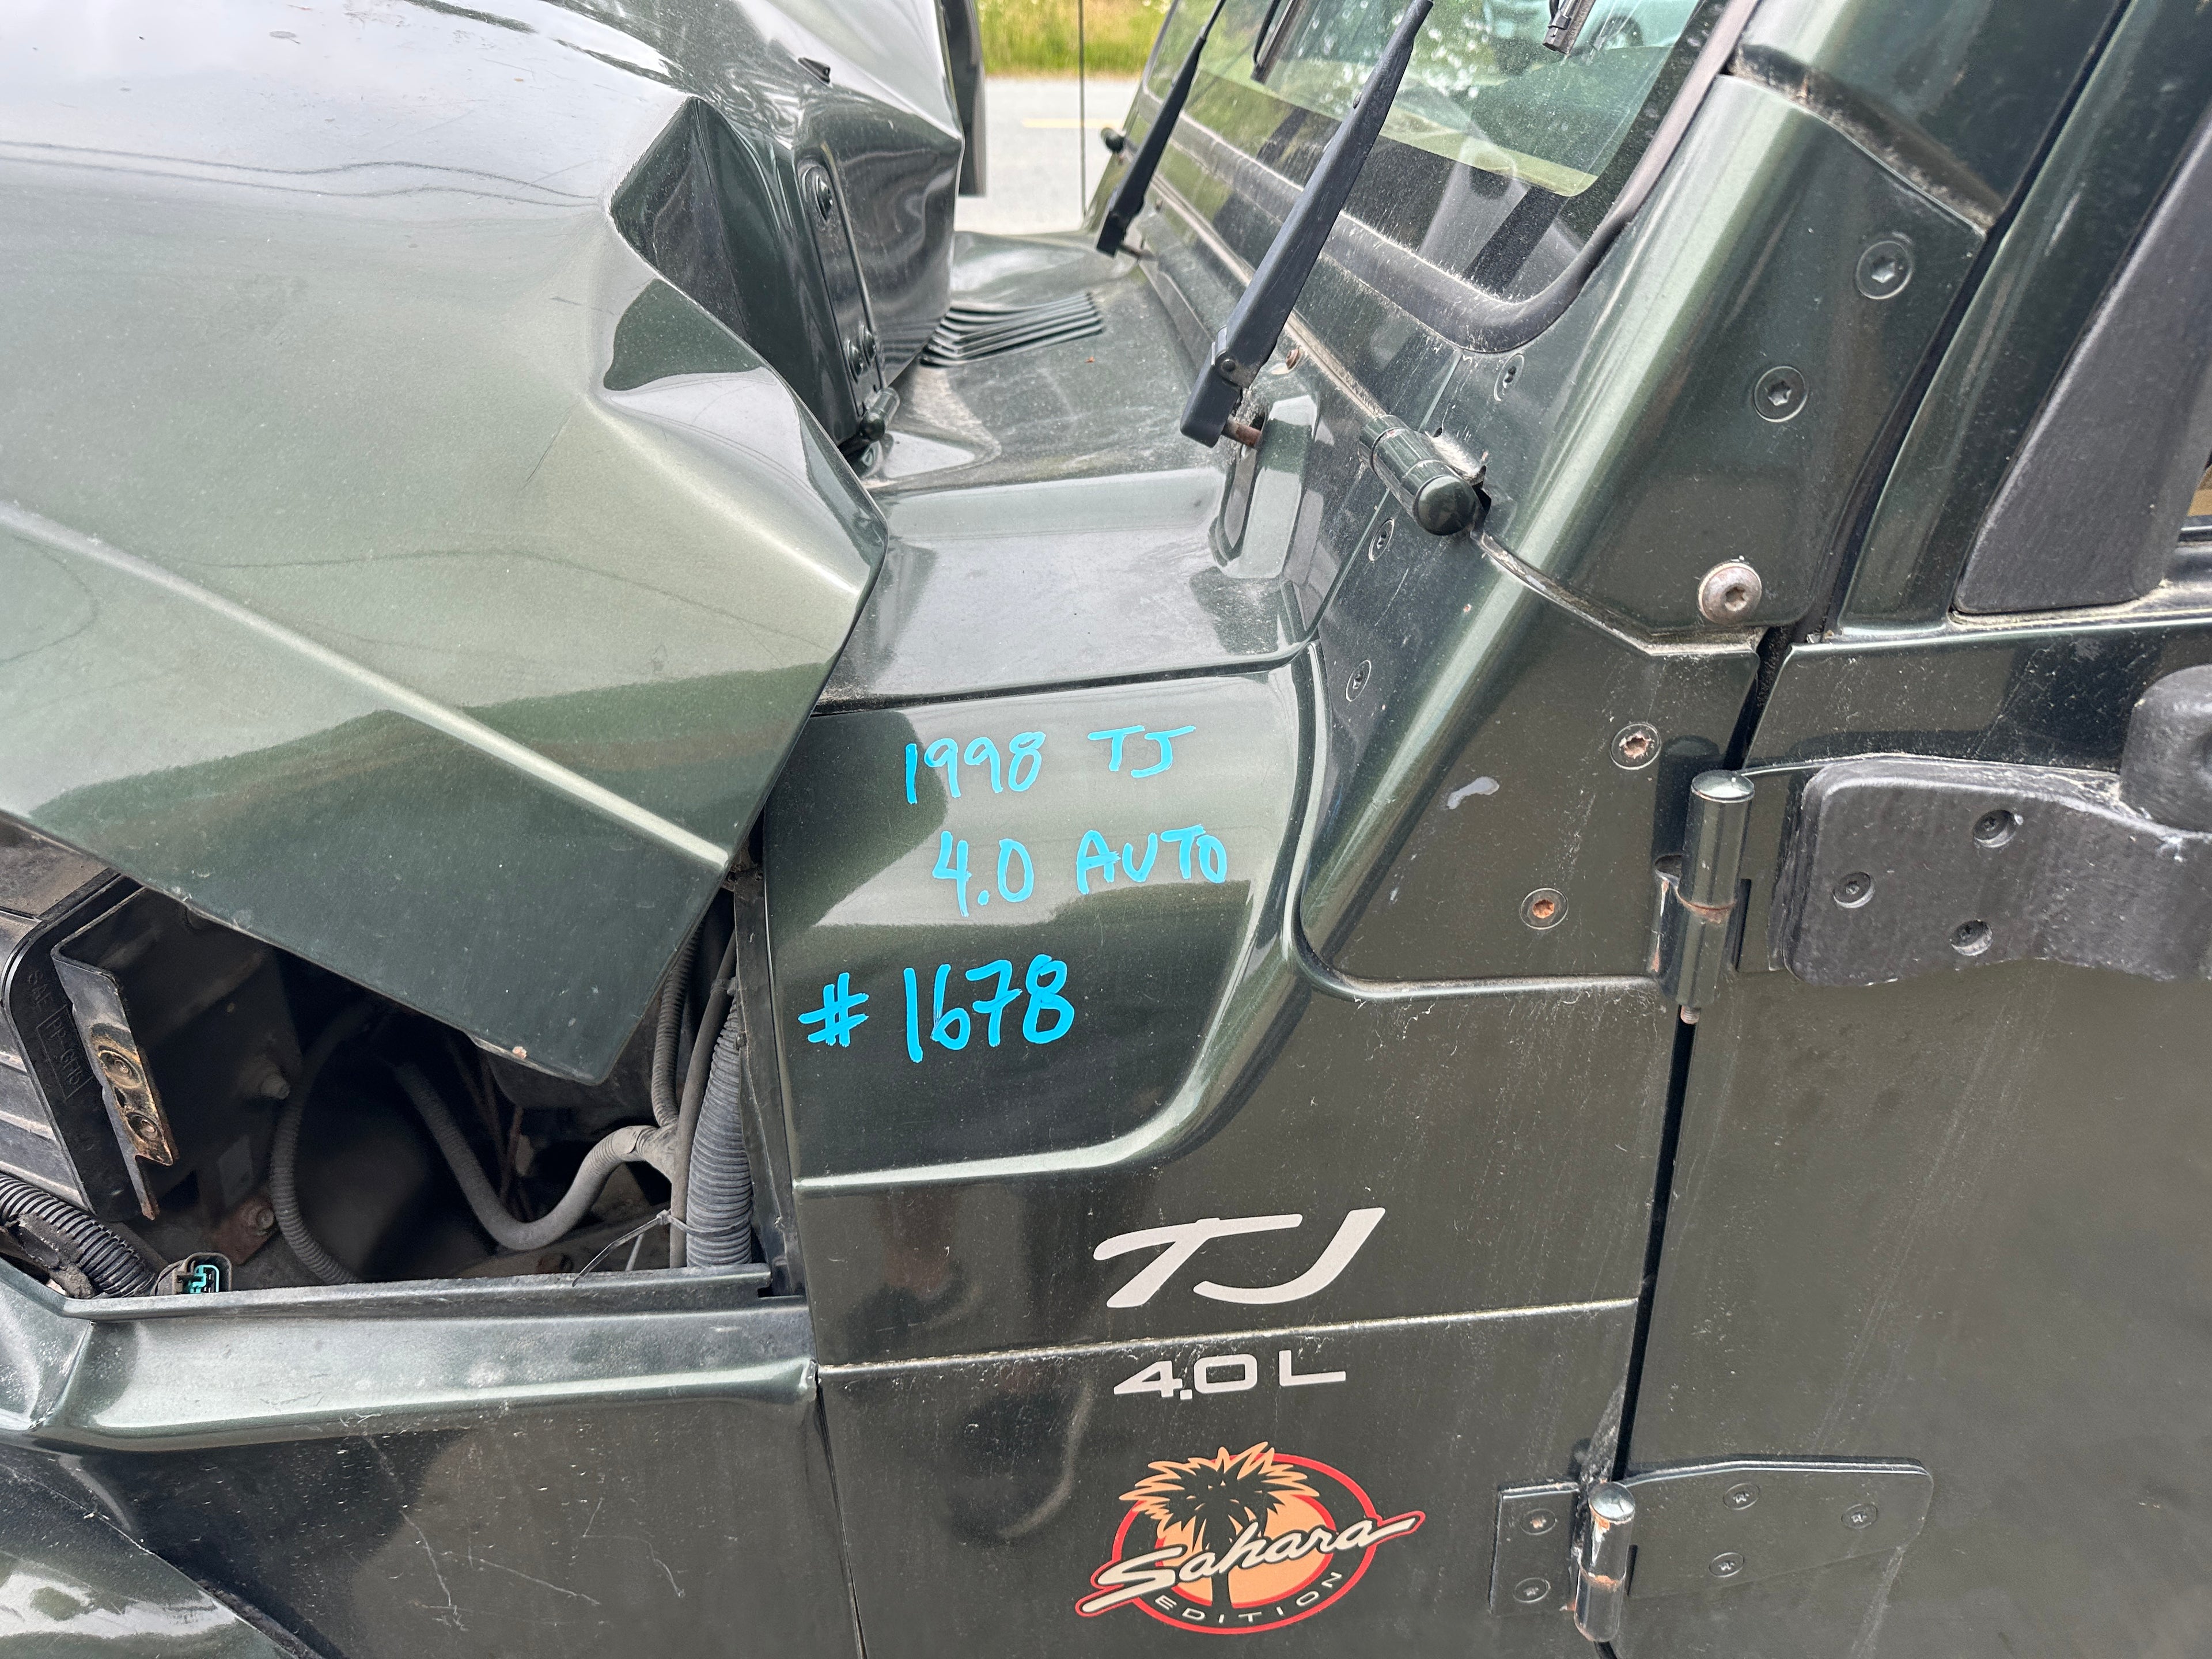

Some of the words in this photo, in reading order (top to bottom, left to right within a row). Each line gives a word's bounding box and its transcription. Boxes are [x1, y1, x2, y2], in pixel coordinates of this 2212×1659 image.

[906, 732, 1046, 804] 1998
[1088, 725, 1196, 778] TJ
[932, 831, 1035, 917] 4.0
[1075, 824, 1227, 895] AUTO
[903, 953, 1075, 1063] 1678
[1093, 1207, 1386, 1308] TJ
[1113, 1354, 1257, 1400] 4.0
[1278, 1350, 1347, 1387] L
[1082, 1517, 1415, 1612] Sahara
[1155, 1572, 1342, 1623] EDITION
